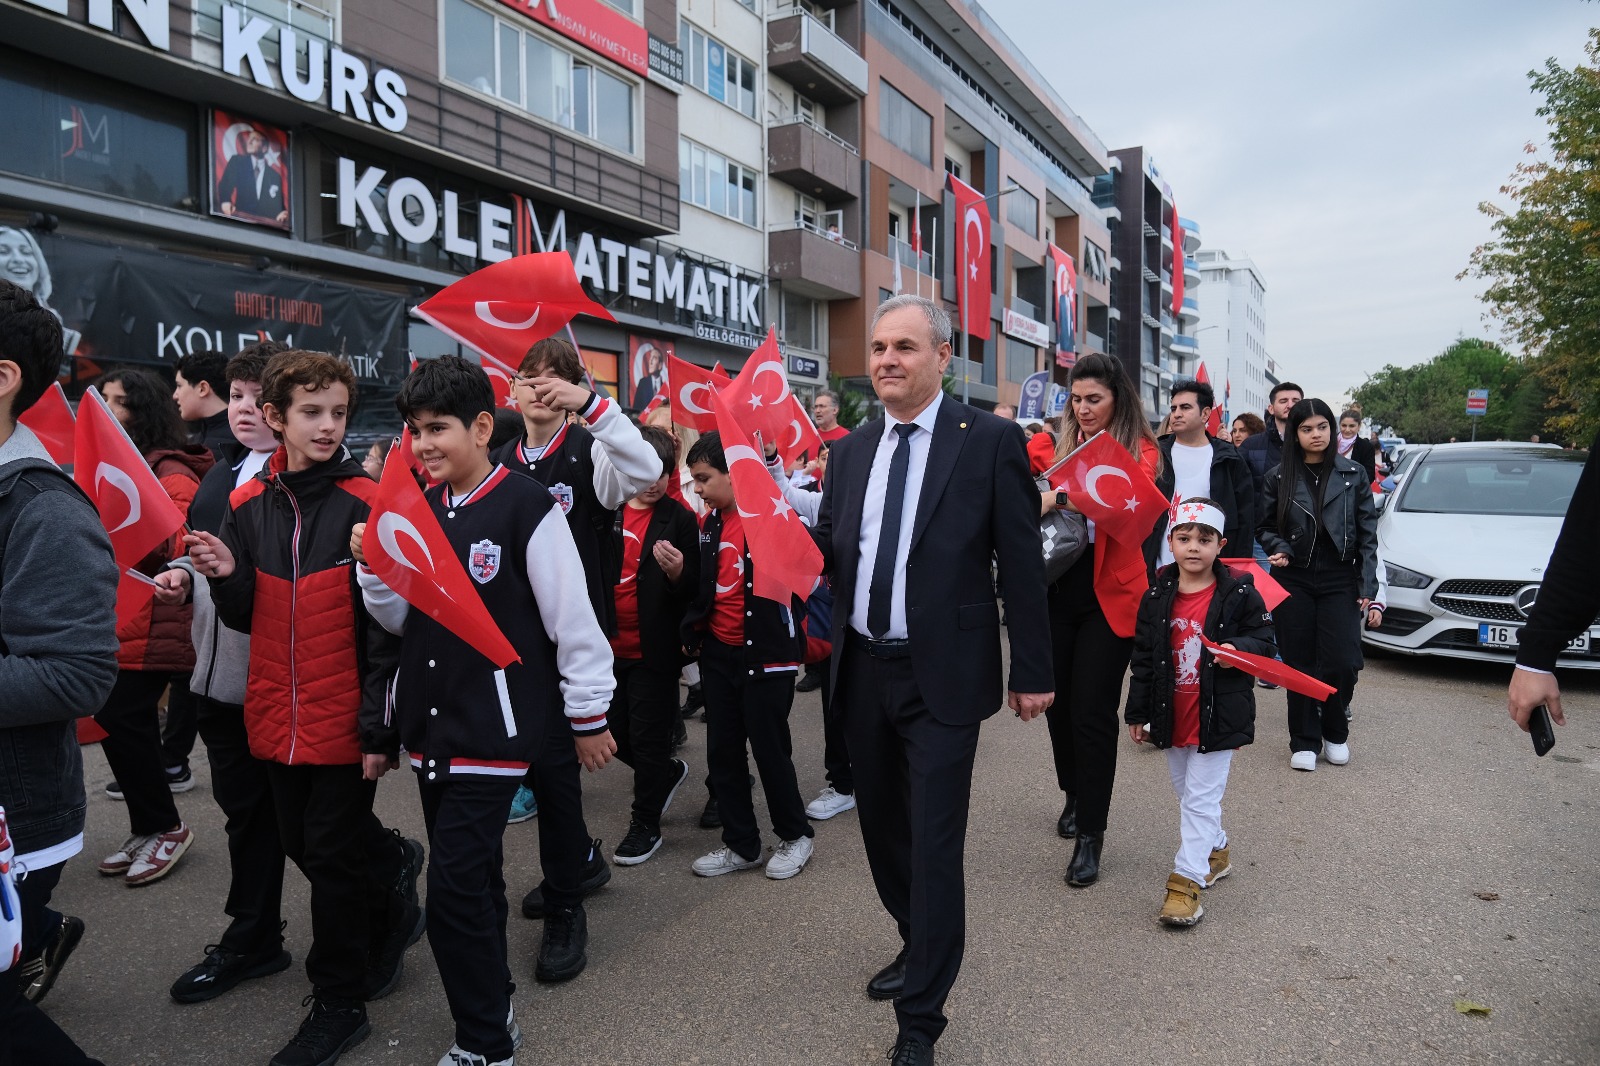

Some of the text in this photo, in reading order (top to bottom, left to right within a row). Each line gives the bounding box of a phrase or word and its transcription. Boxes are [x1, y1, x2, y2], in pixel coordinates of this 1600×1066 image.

[222, 4, 408, 133] KURS
[235, 290, 276, 321] AHMET
[697, 324, 720, 340] ÖZEL
[721, 331, 759, 349] ÖĞRETİM
[1490, 627, 1508, 643] 16
